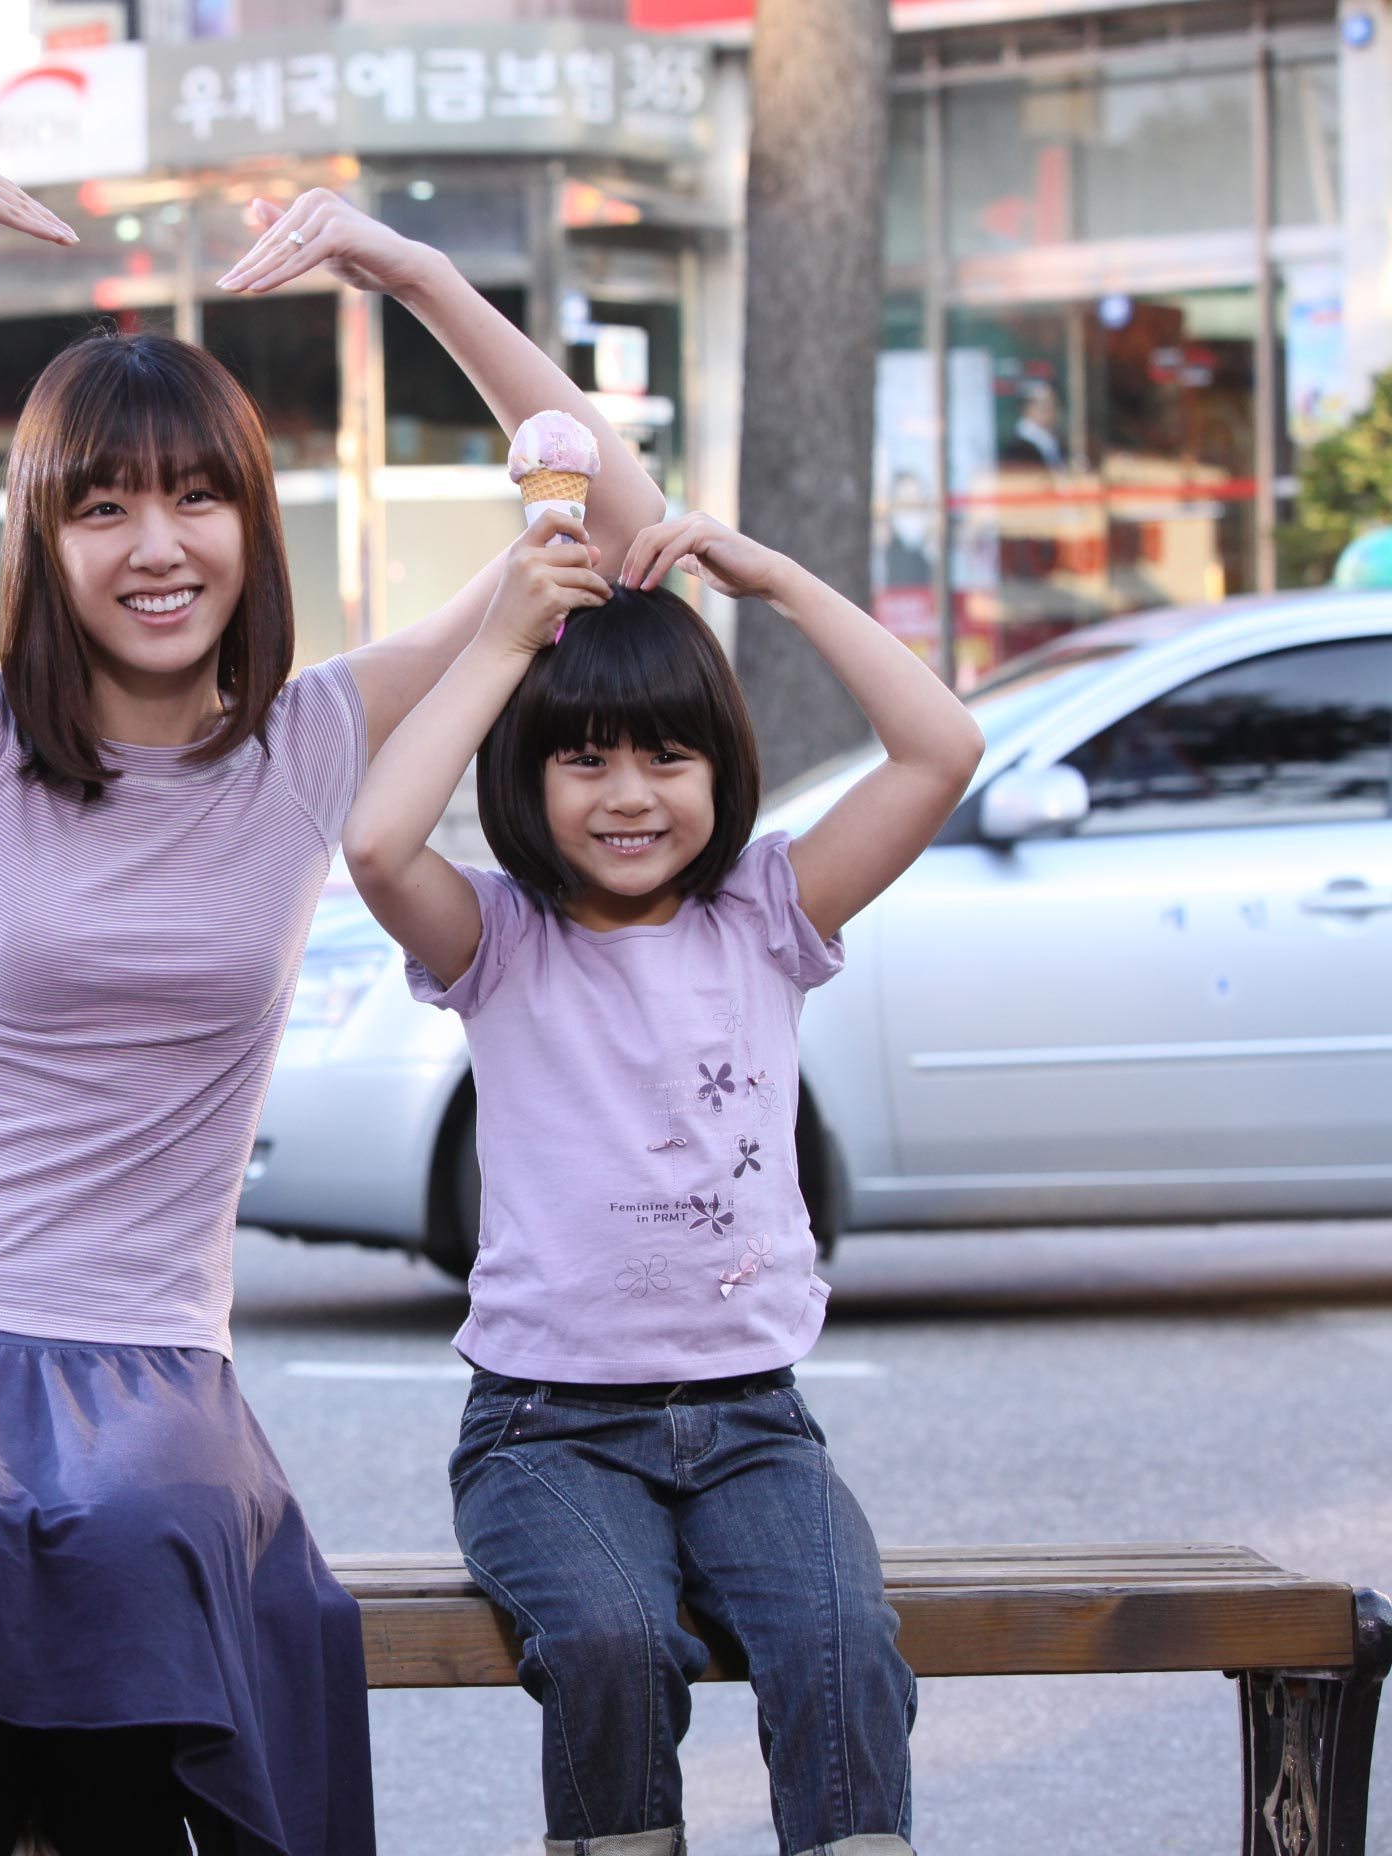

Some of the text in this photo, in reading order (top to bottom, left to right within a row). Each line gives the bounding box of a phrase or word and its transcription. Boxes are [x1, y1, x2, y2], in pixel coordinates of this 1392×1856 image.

[610, 1202, 669, 1212] Feminine
[636, 1212, 688, 1223] in PRMT
